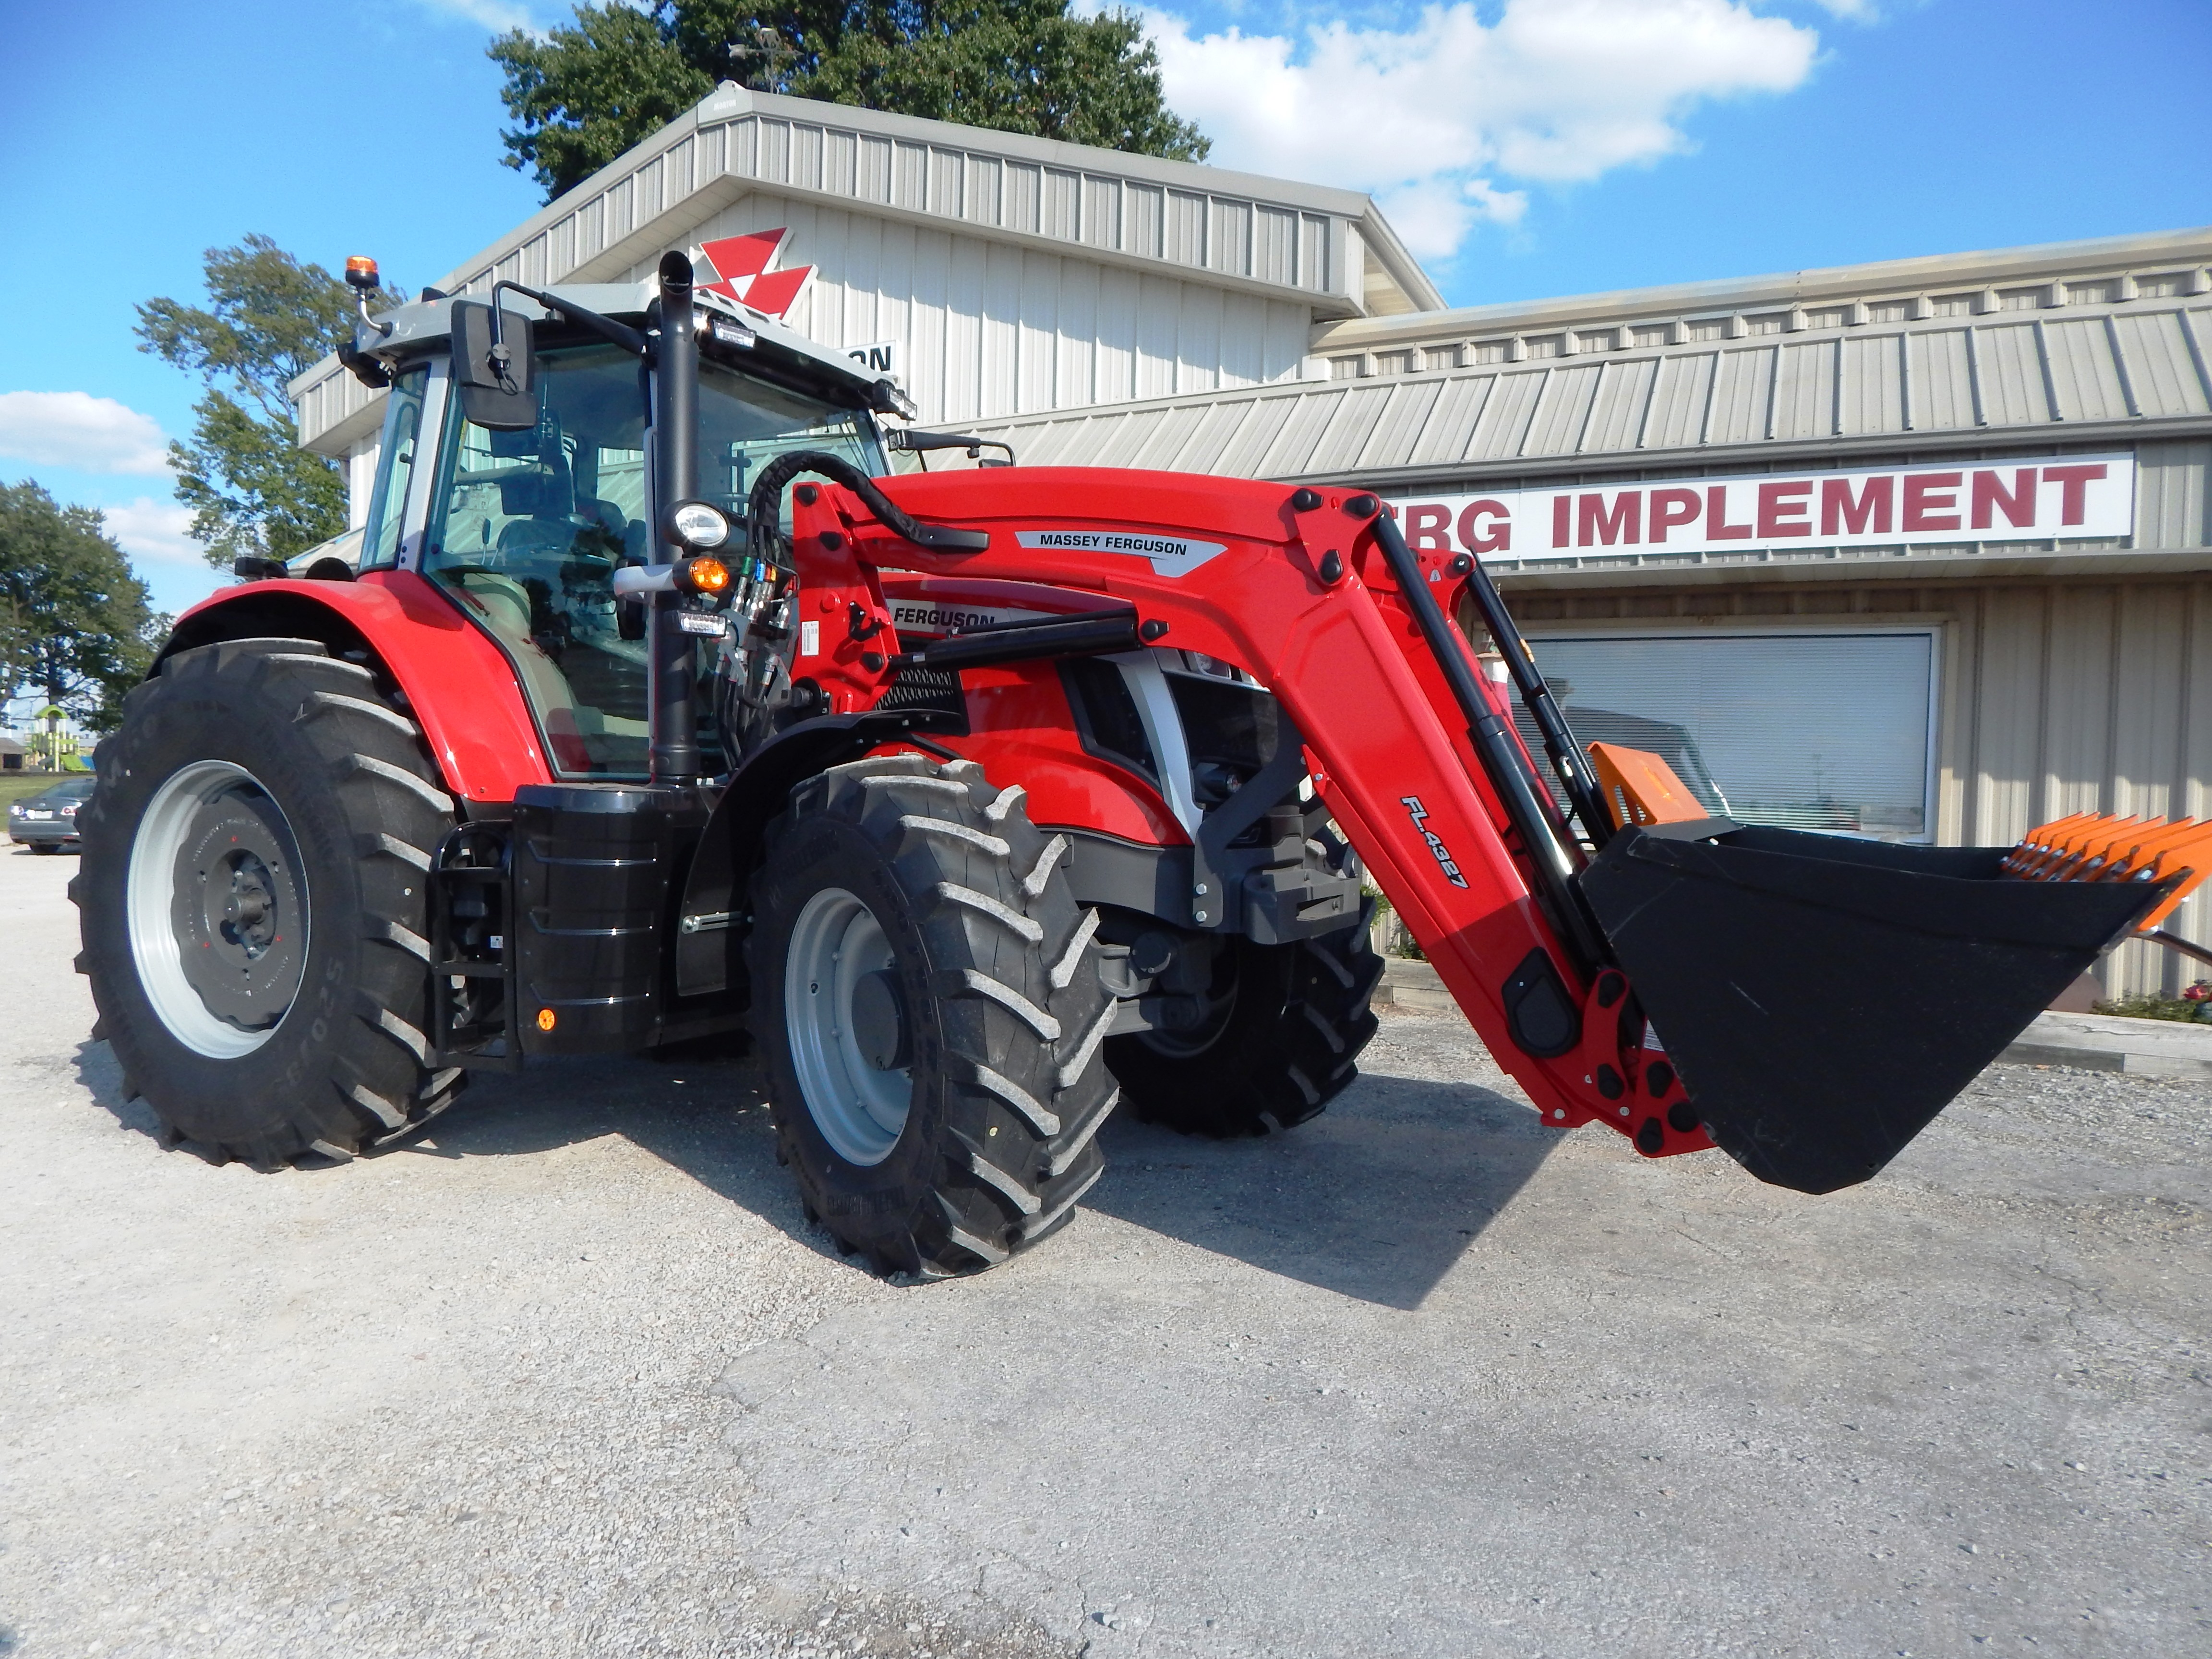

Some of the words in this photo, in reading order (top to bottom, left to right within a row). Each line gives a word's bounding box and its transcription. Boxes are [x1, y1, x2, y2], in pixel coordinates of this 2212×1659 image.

[1040, 534, 1100, 547] MASSEY
[1105, 537, 1187, 555] FERGUSON
[1394, 500, 1511, 553] RG
[1552, 463, 2108, 548] IMPLEMENT
[1400, 795, 1470, 889] FL.4327
